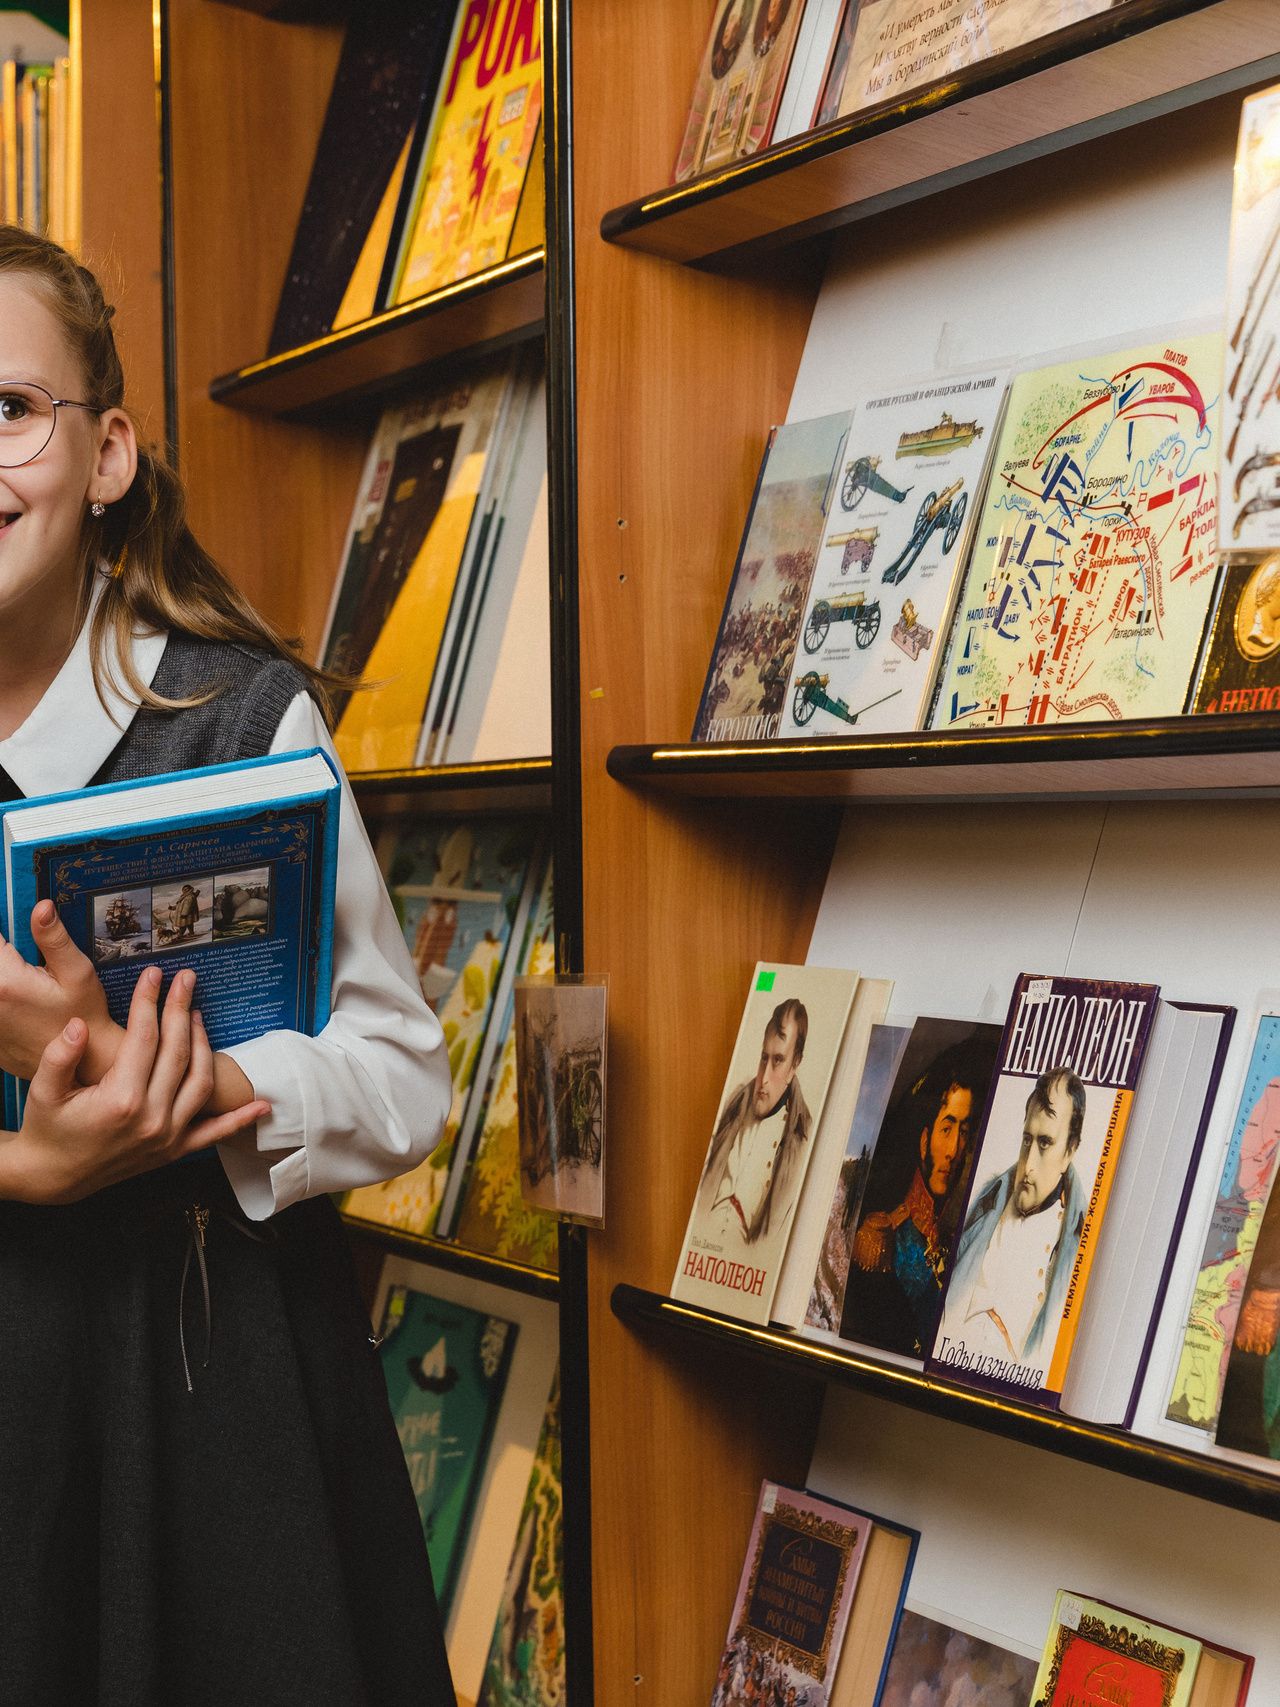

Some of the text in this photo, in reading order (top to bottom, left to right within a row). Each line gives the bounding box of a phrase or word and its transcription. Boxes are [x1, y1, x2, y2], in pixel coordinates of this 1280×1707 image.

[896, 6, 935, 40] умереть
[872, 52, 884, 69] И
[884, 38, 918, 64] клятву
[920, 14, 963, 47] верности
[865, 76, 883, 96] Мы
[885, 73, 893, 86] в
[894, 36, 958, 83] бородинский
[1163, 349, 1189, 367] ПЛАТОВ
[865, 397, 891, 411] ОРУЖИЕ
[891, 391, 919, 406] РУССКОЙ
[924, 381, 972, 400] ФРАНЦУЗСКОЙ
[971, 376, 997, 391] АРМИЙ
[1083, 384, 1121, 400] Беззубово
[1148, 382, 1176, 396] УВАРОВ
[1054, 434, 1082, 448] БОГАРНЕ
[1147, 432, 1181, 467] Колоча
[1003, 459, 1030, 472] Валуева
[1087, 473, 1128, 490] Бородино
[1024, 508, 1038, 521] НЕЙ
[1101, 516, 1122, 528] Горки
[1179, 496, 1219, 532] БАРКЛА
[1116, 526, 1151, 542] КУТУЗОВ
[1089, 553, 1146, 569] Батарея Раевского
[1190, 562, 1215, 586] резерв
[1108, 578, 1129, 623] ЛАВРОВ
[1003, 613, 1020, 626] ДАВУ
[1112, 627, 1155, 639] Татариново
[1056, 607, 1084, 685] БАГРАТИОН
[1074, 692, 1110, 711] Смоленская
[706, 713, 780, 742] БОРОДИНС
[84, 836, 281, 876] ПУТЕШЕСТВИЕ ФЛОТА КАПИТАНА САРЫЧЕВА
[155, 844, 168, 854] А.
[169, 836, 220, 853] Сарычев
[1002, 991, 1147, 1085] НАПОЛЕОН
[1063, 1092, 1124, 1319] МЕМУАРЫ ЛУИ-ЖОЗЕФА МАРШАНА
[683, 1250, 767, 1296] НАПОЛЕОН
[937, 1336, 1044, 1391] Годы изгнания
